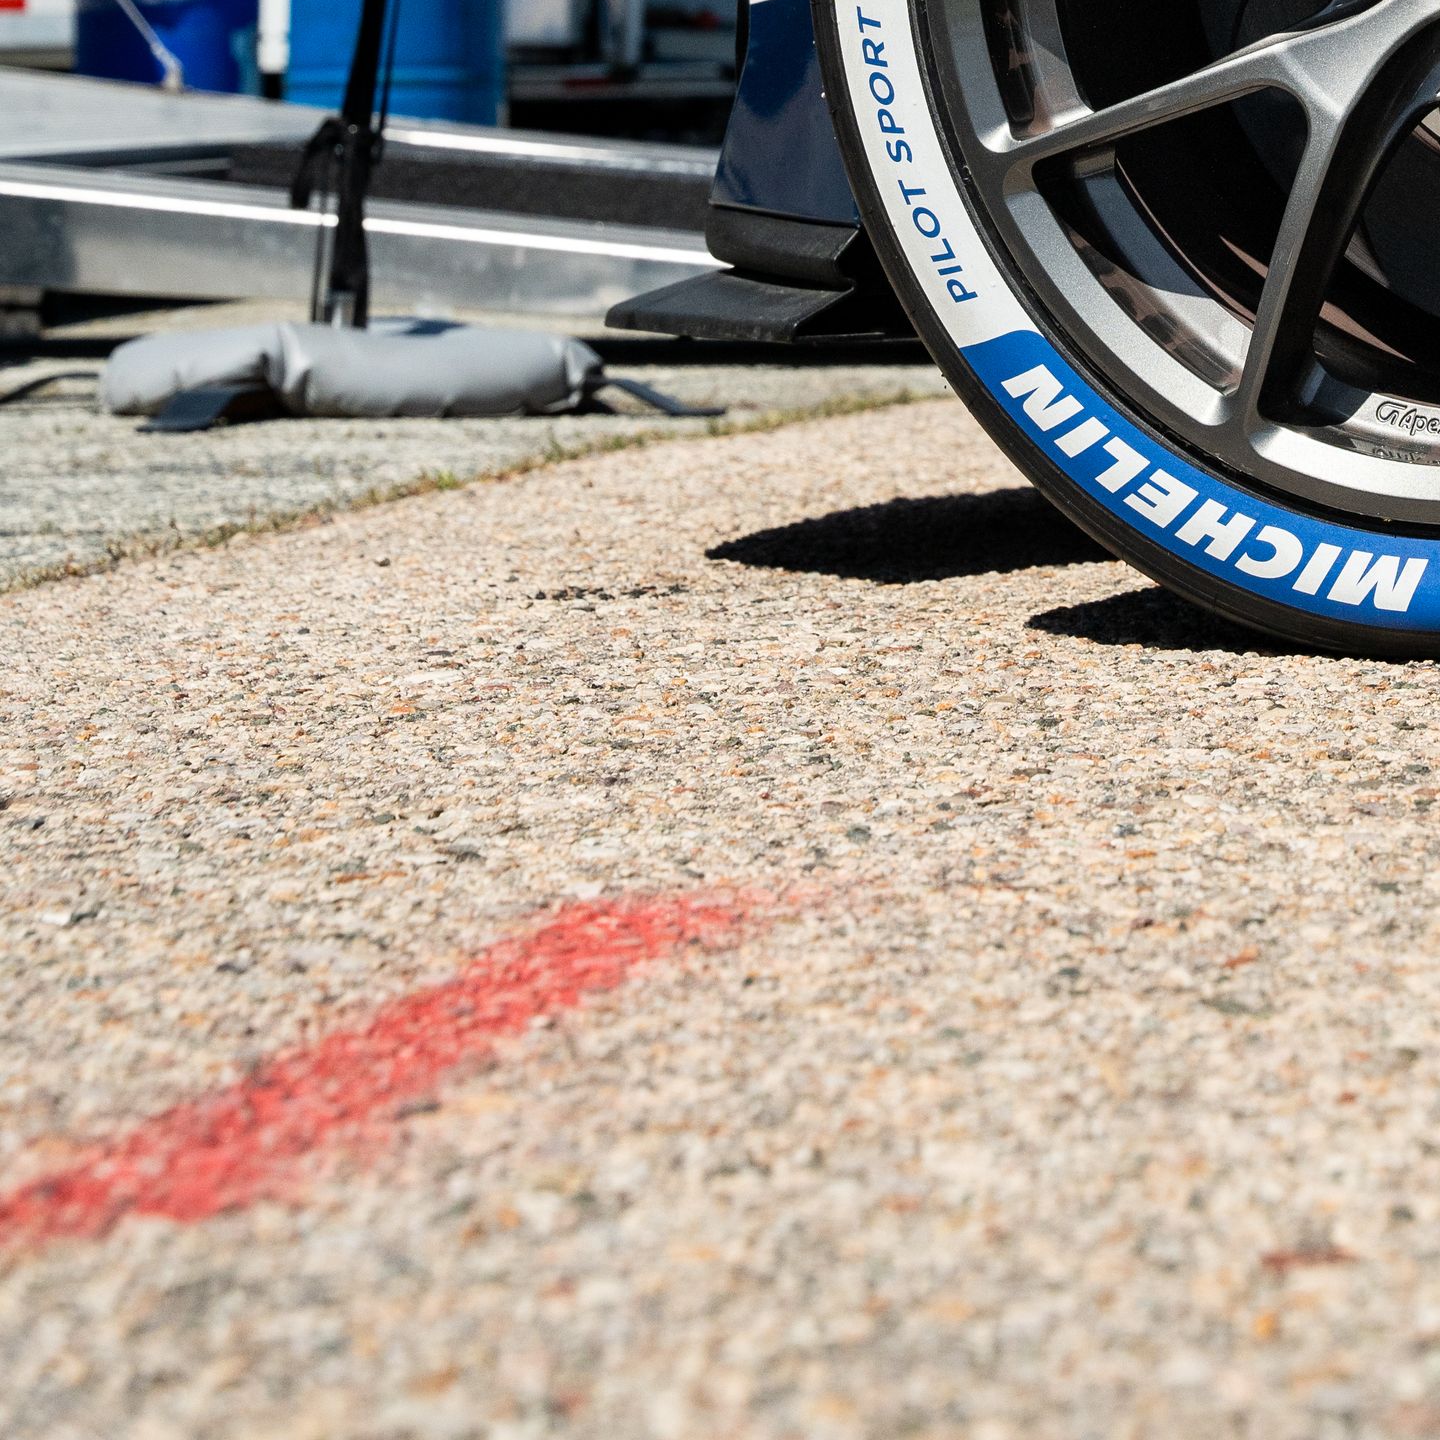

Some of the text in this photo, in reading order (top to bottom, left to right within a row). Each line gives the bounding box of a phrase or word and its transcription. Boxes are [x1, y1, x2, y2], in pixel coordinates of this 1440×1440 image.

[856, 6, 979, 304] PILOT SPORT
[1000, 363, 1430, 614] MICHELIN
